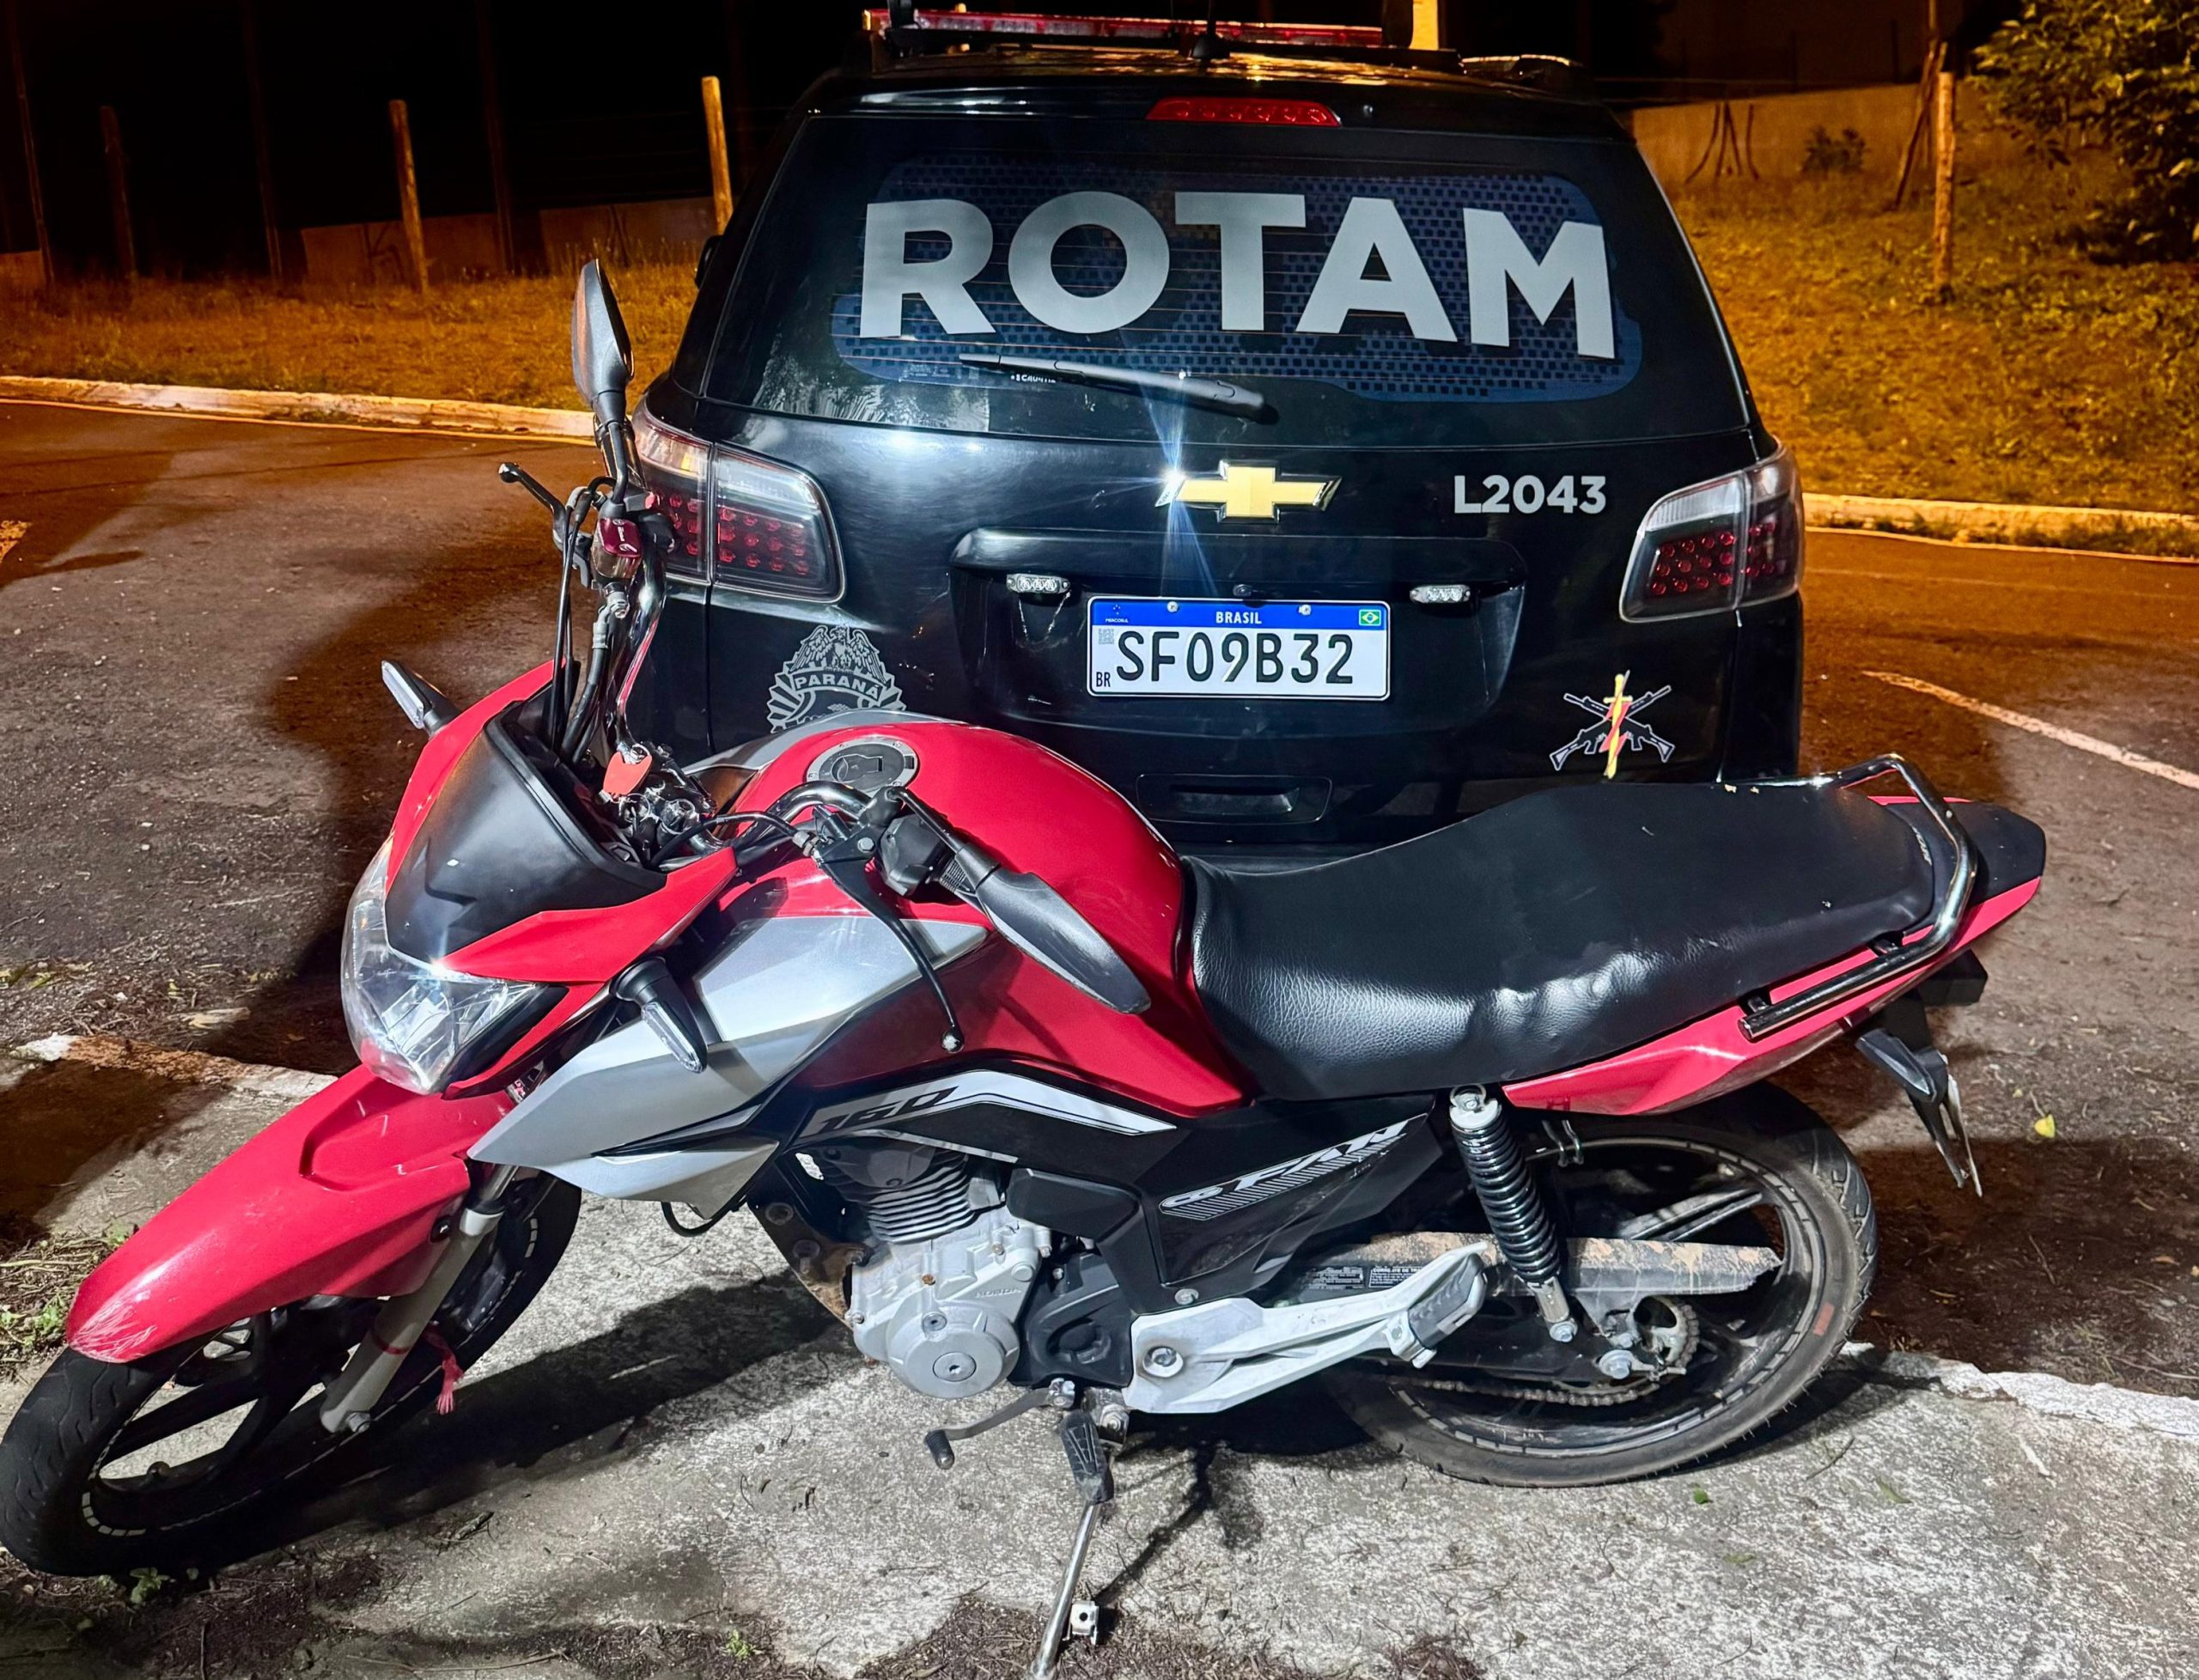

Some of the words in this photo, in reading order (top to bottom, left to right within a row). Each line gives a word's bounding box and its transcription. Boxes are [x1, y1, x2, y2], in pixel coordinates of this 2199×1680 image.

[859, 191, 1616, 360] ROTAM
[1454, 475, 1606, 514] L2043
[1215, 611, 1263, 625] BRASIL
[794, 673, 880, 699] PARANÁ
[1095, 672, 1111, 688] BR
